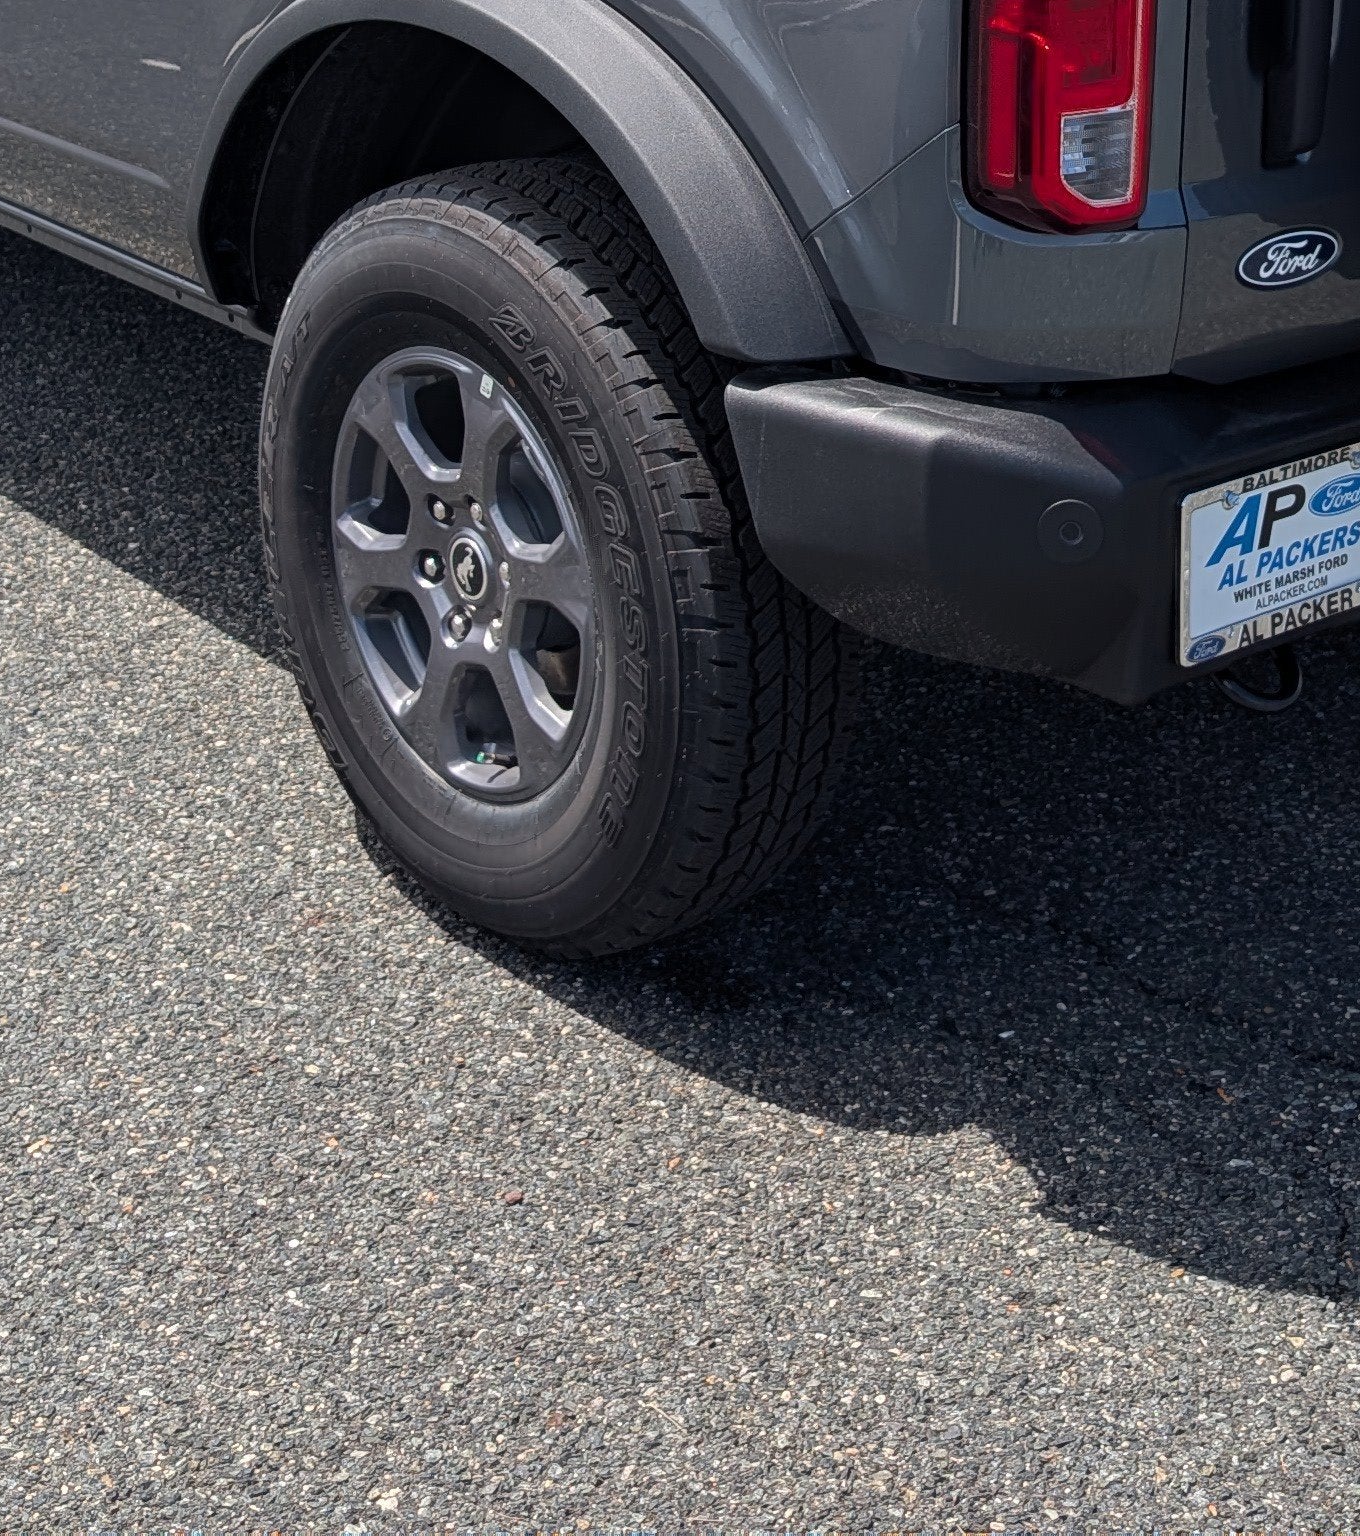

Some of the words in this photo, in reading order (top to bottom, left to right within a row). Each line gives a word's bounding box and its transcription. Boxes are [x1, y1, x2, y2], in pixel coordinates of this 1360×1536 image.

[1258, 238, 1324, 279] Ford
[1242, 447, 1351, 493] BALTIMORE
[1205, 484, 1306, 568] AP
[487, 303, 651, 850] BRIDGESTONE
[1217, 562, 1248, 591] AL
[1233, 579, 1272, 603] WHITE
[1274, 567, 1315, 589] MARSH
[1318, 554, 1348, 572] FORD
[1255, 575, 1328, 611] ALPACKER.COM
[1239, 619, 1264, 648] AL
[1270, 588, 1353, 637] PACKER
